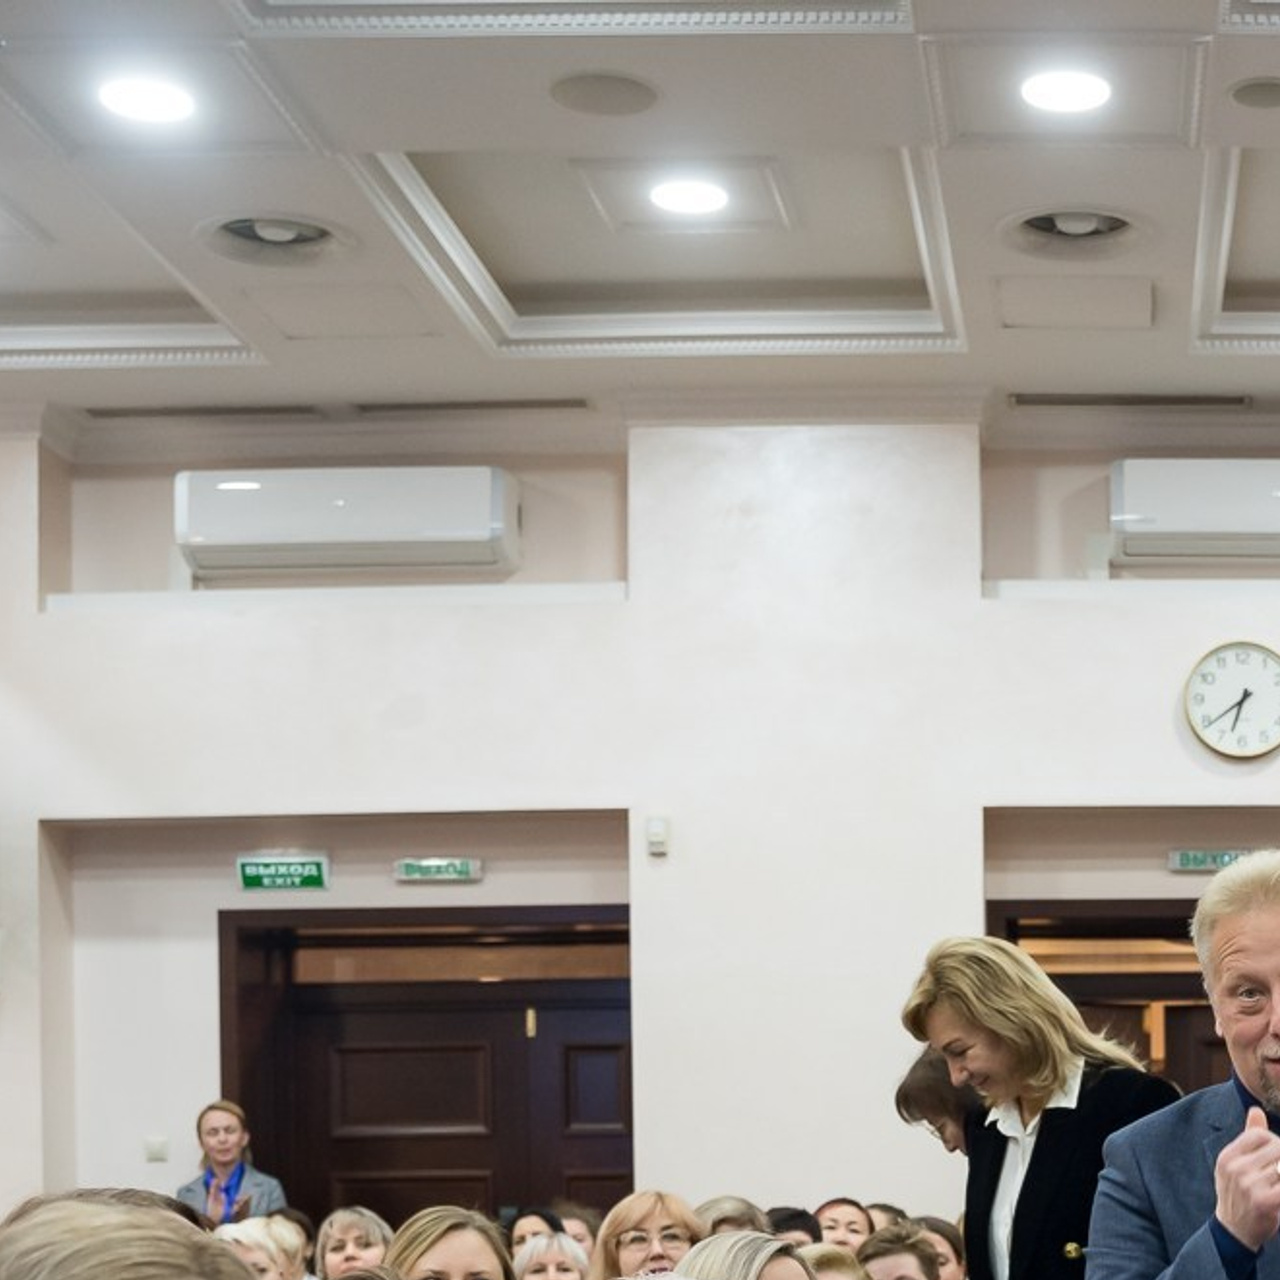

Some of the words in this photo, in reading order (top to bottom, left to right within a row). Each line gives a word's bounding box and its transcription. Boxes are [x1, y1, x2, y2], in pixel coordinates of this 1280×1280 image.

[1235, 651, 1251, 665] 12
[244, 864, 318, 877] ВЫХОД
[262, 877, 302, 887] EXIT
